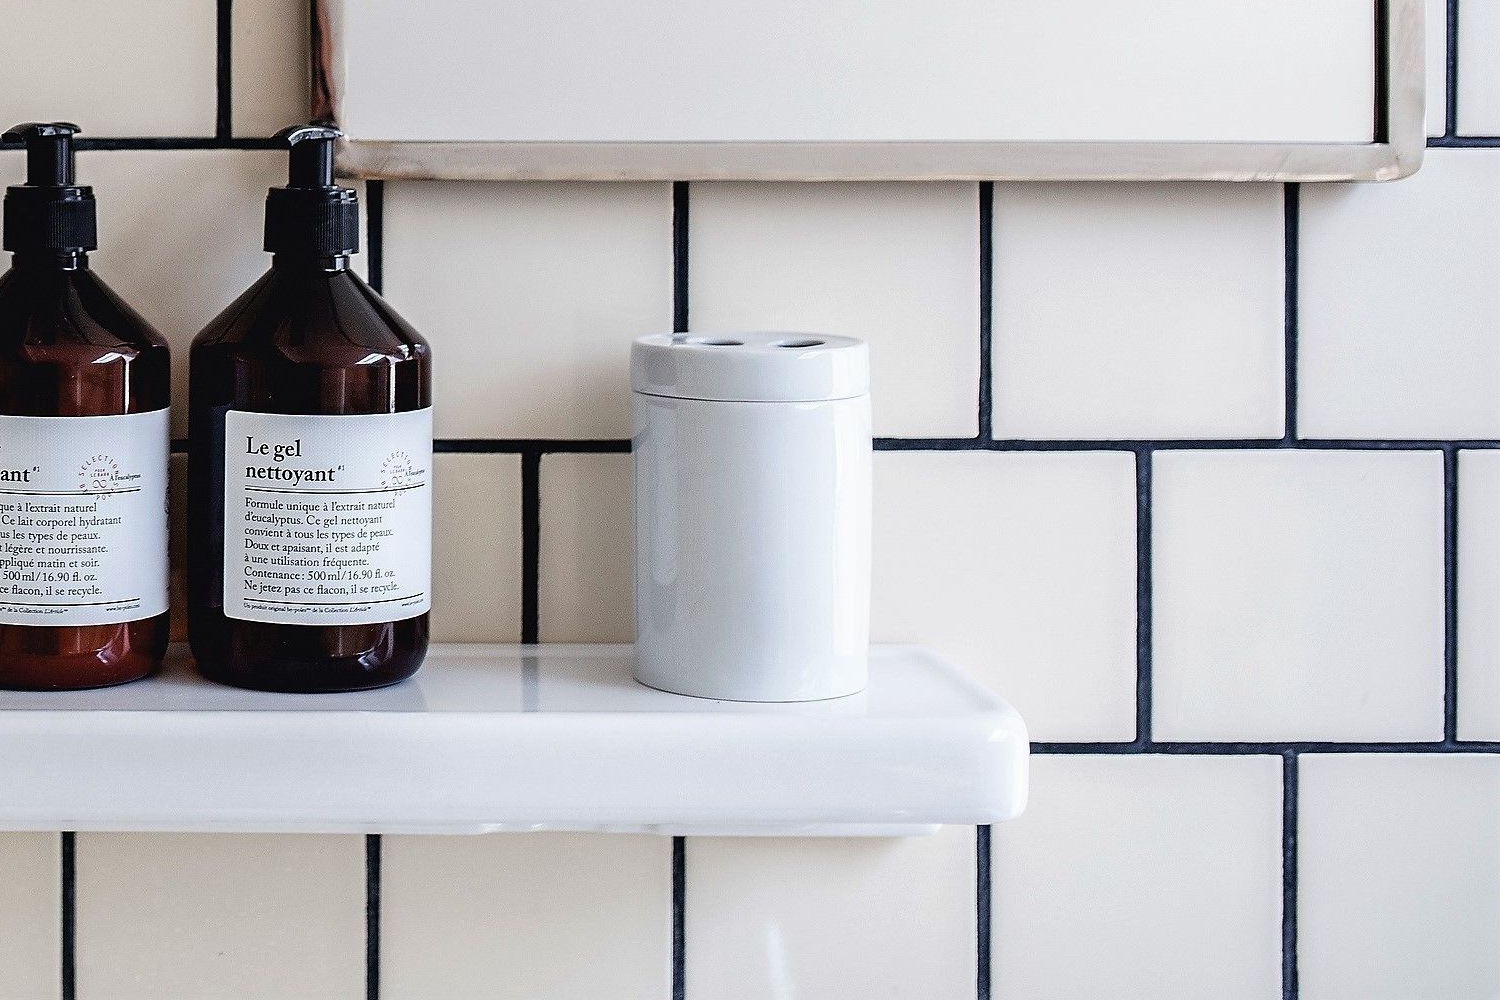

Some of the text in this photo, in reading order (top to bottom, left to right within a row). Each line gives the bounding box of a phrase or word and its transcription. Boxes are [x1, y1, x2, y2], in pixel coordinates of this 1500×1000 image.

[246, 436, 302, 461] Le gel
[246, 466, 335, 486] nettoyant
[17, 502, 22, 512] à
[26, 502, 60, 513] l'extrait
[64, 503, 97, 513] naturel
[245, 497, 395, 514] Formule unique à l'extrait naturel
[2, 516, 15, 526] Ce
[18, 517, 33, 526] lait
[36, 517, 76, 529] corporel
[79, 516, 121, 528] hydratant
[306, 516, 321, 525] Ce
[324, 516, 338, 528] gel
[341, 516, 382, 528] nettoyant
[13, 530, 25, 540] les
[28, 532, 53, 544] types
[57, 530, 68, 541] de
[71, 531, 101, 543] peaux.
[245, 527, 283, 538] convient
[286, 528, 291, 537] à
[294, 530, 314, 538] tous
[317, 529, 329, 539] les
[332, 530, 355, 541] types
[358, 528, 367, 538] de
[5, 543, 33, 557] légère
[36, 546, 45, 554] et
[48, 545, 108, 554] nourrissante.
[245, 539, 269, 550] Doux
[271, 542, 279, 550] et
[282, 543, 324, 555] apaisant,
[326, 544, 332, 553] il
[351, 542, 380, 554] adapté
[38, 558, 65, 568] matin
[69, 559, 77, 568] et
[81, 558, 99, 567] soir.
[244, 553, 369, 569] à une utilisation fréquente.
[73, 572, 81, 582] fl.
[375, 569, 383, 578] fl.
[0, 586, 9, 594] ce
[12, 585, 43, 596] flacon,
[46, 586, 52, 595] il
[68, 586, 102, 598] recycle.
[244, 581, 257, 590] Ne
[260, 582, 282, 594] jetez
[285, 586, 301, 596] pas
[317, 584, 348, 595] flacon,
[350, 584, 357, 594] il
